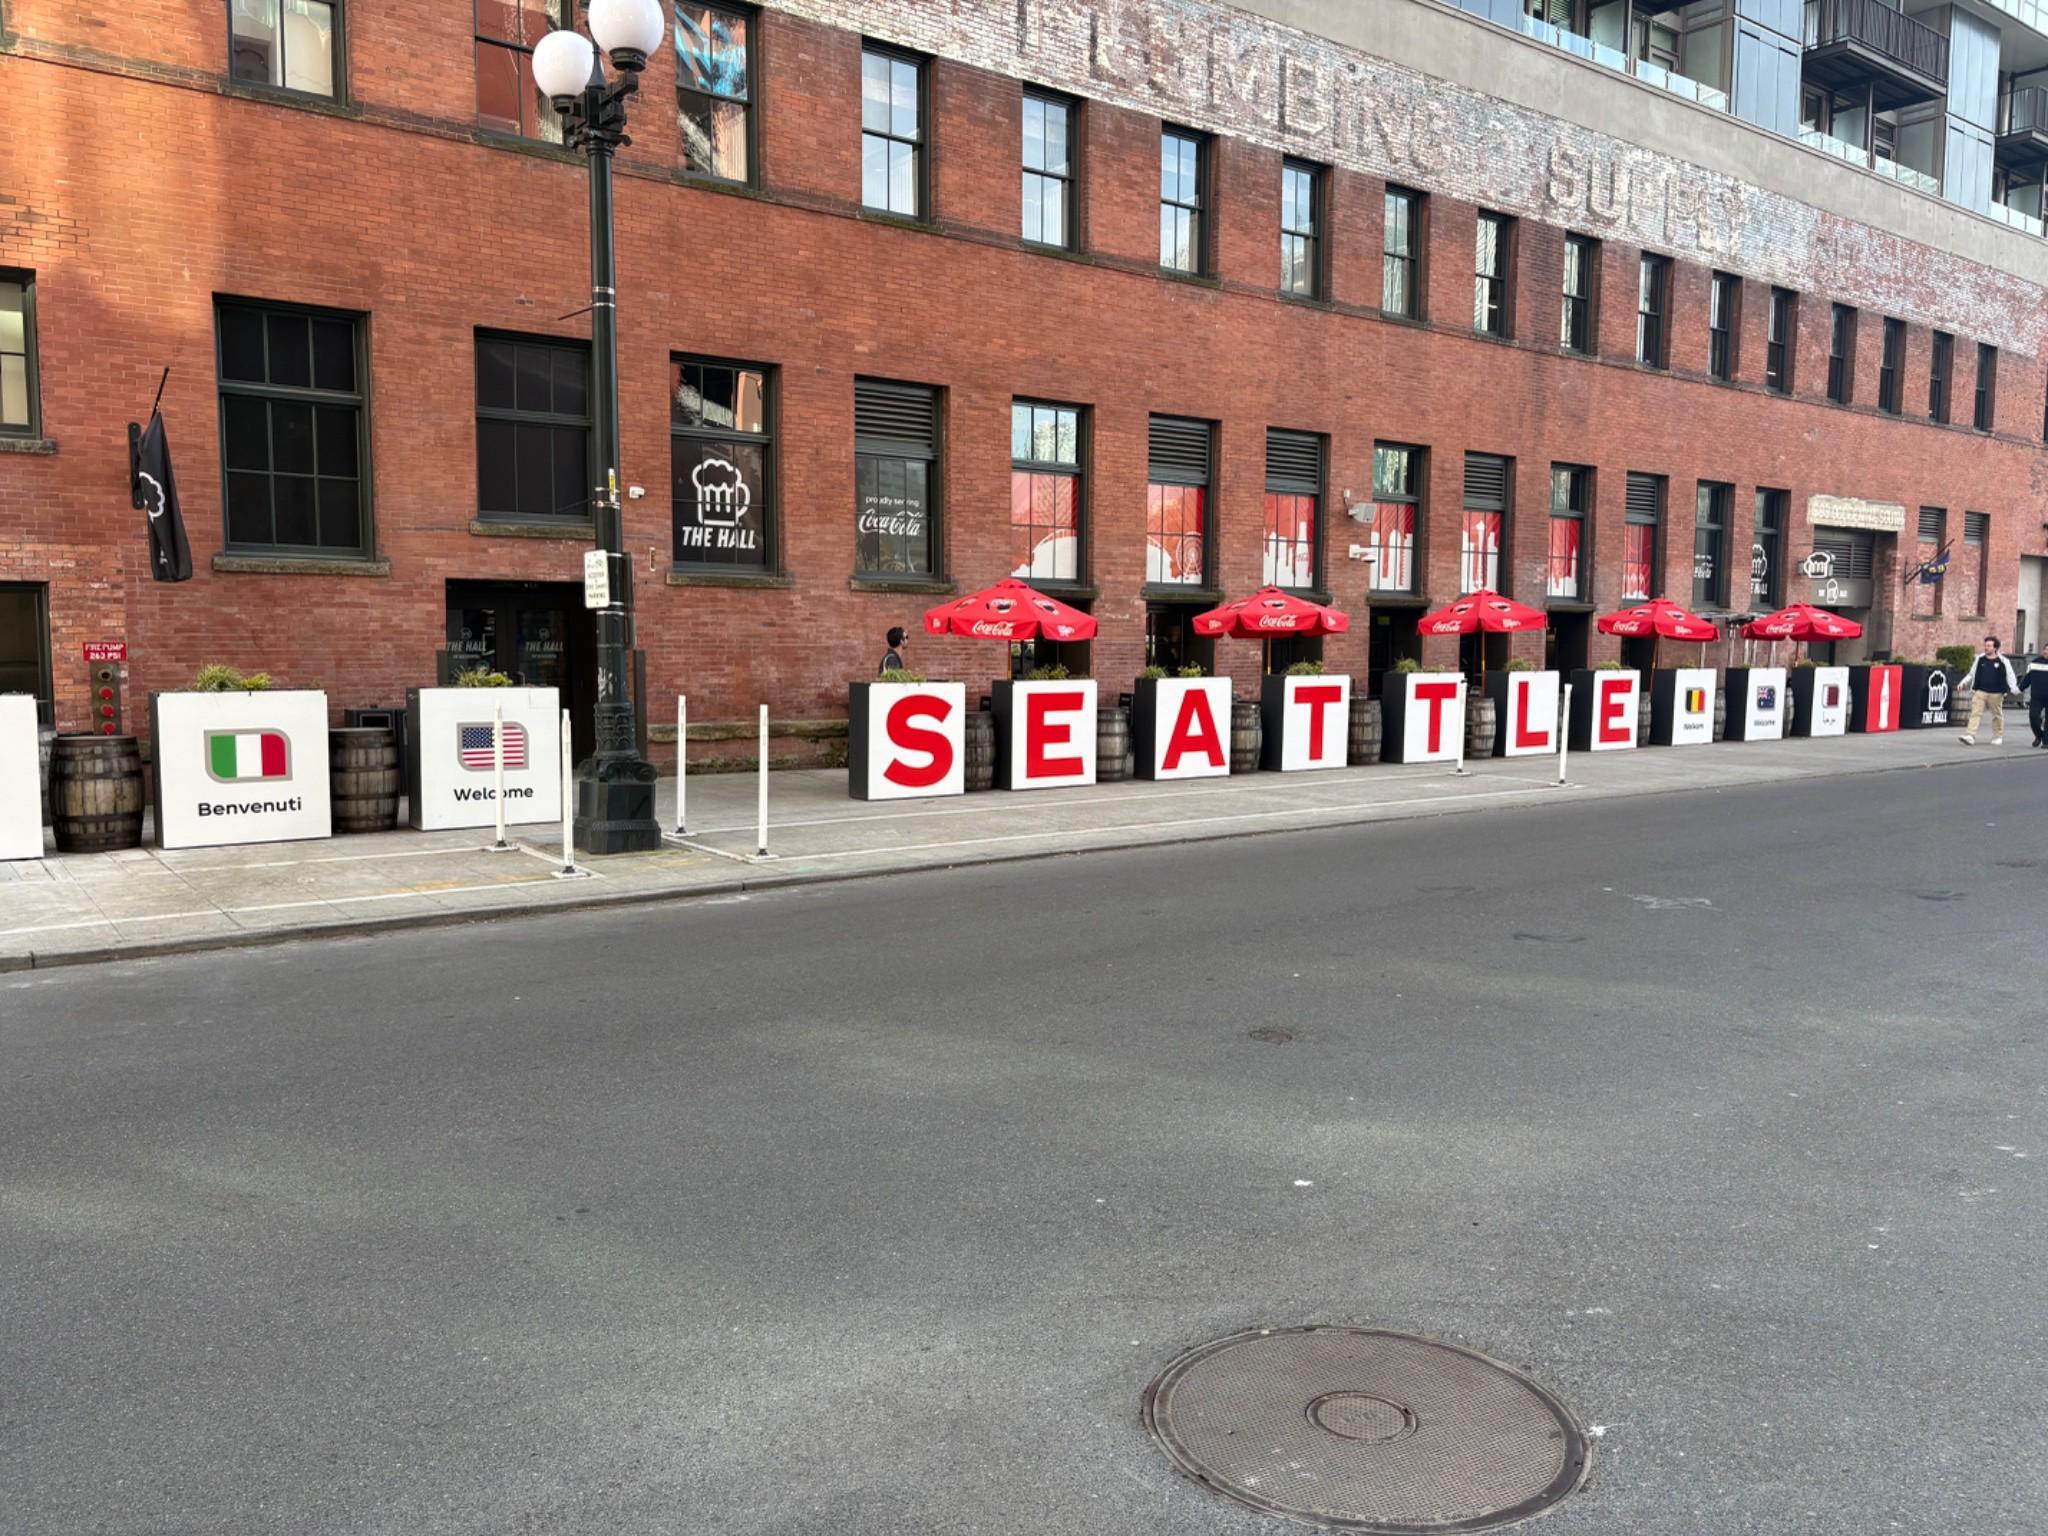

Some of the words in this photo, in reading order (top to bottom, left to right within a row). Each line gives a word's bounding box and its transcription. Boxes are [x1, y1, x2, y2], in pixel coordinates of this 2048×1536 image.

[682, 526, 712, 548] THE
[716, 527, 756, 550] HALL
[525, 640, 541, 652] THE
[543, 640, 564, 652] HALL
[197, 796, 303, 817] Benvenuti
